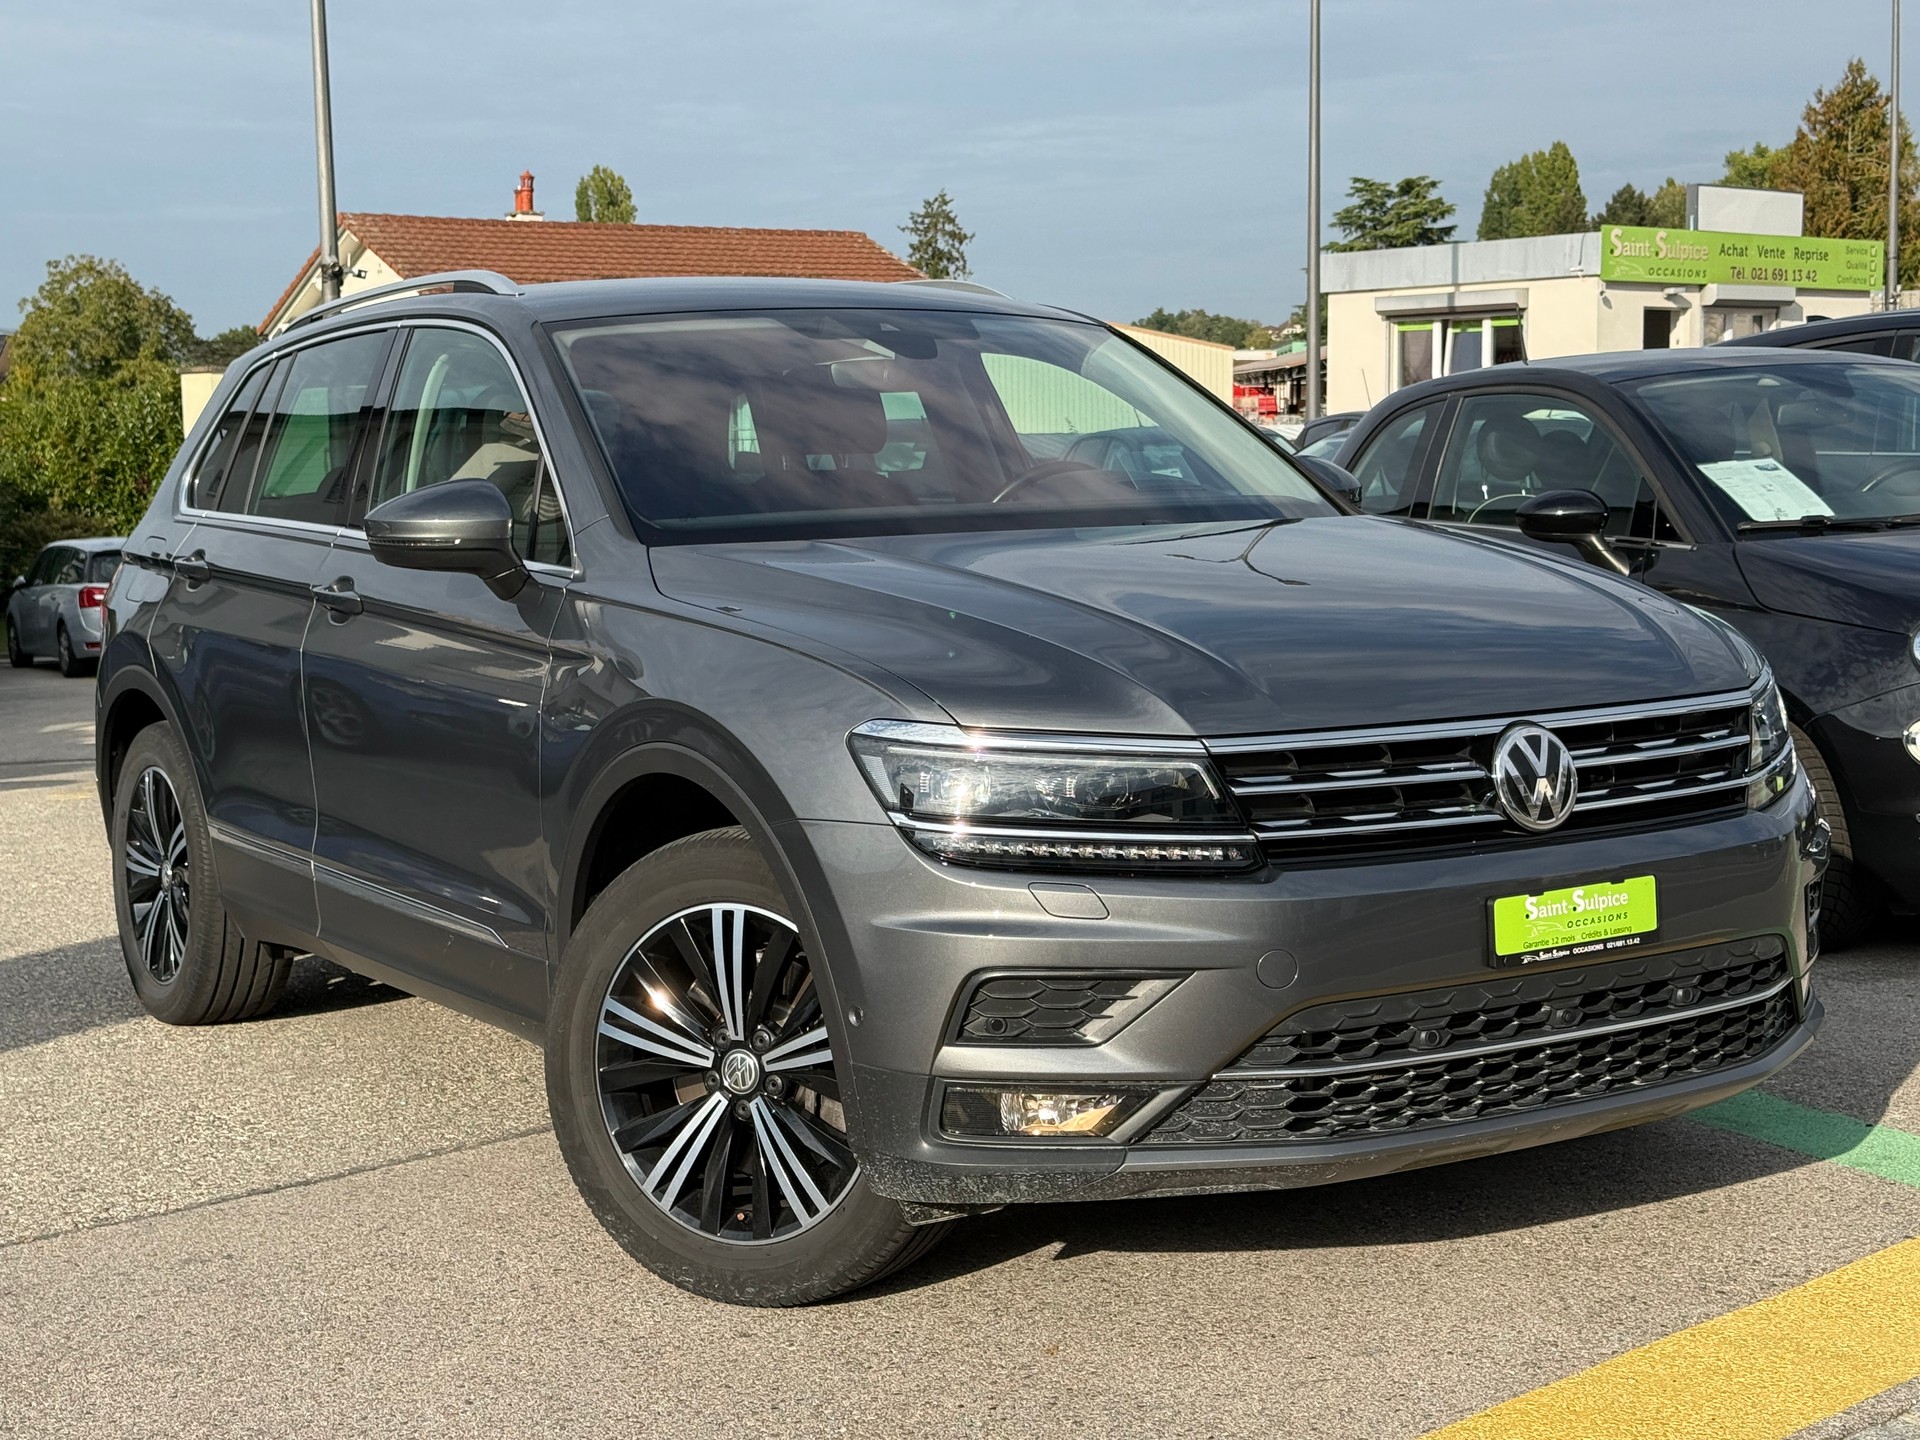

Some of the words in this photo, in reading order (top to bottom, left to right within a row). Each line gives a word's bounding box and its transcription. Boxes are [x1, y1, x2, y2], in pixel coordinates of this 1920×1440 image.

[1719, 243, 1749, 258] Achat
[1757, 245, 1785, 259] Vente
[1794, 247, 1829, 263] Reprise
[1648, 267, 1708, 278] OCCASIONS
[1751, 268, 1768, 280] 021
[1772, 269, 1788, 282] 691
[1792, 269, 1803, 282] 13
[1806, 270, 1818, 282] 42
[1567, 912, 1628, 929] OCCASIONS
[1523, 939, 1550, 949] Garantie
[1551, 936, 1559, 945] 12
[1561, 934, 1576, 943] mois
[1581, 929, 1602, 940] Crédits
[1603, 928, 1609, 936] &
[1609, 925, 1632, 936] Leasing
[1573, 943, 1604, 954] OCCASIONS
